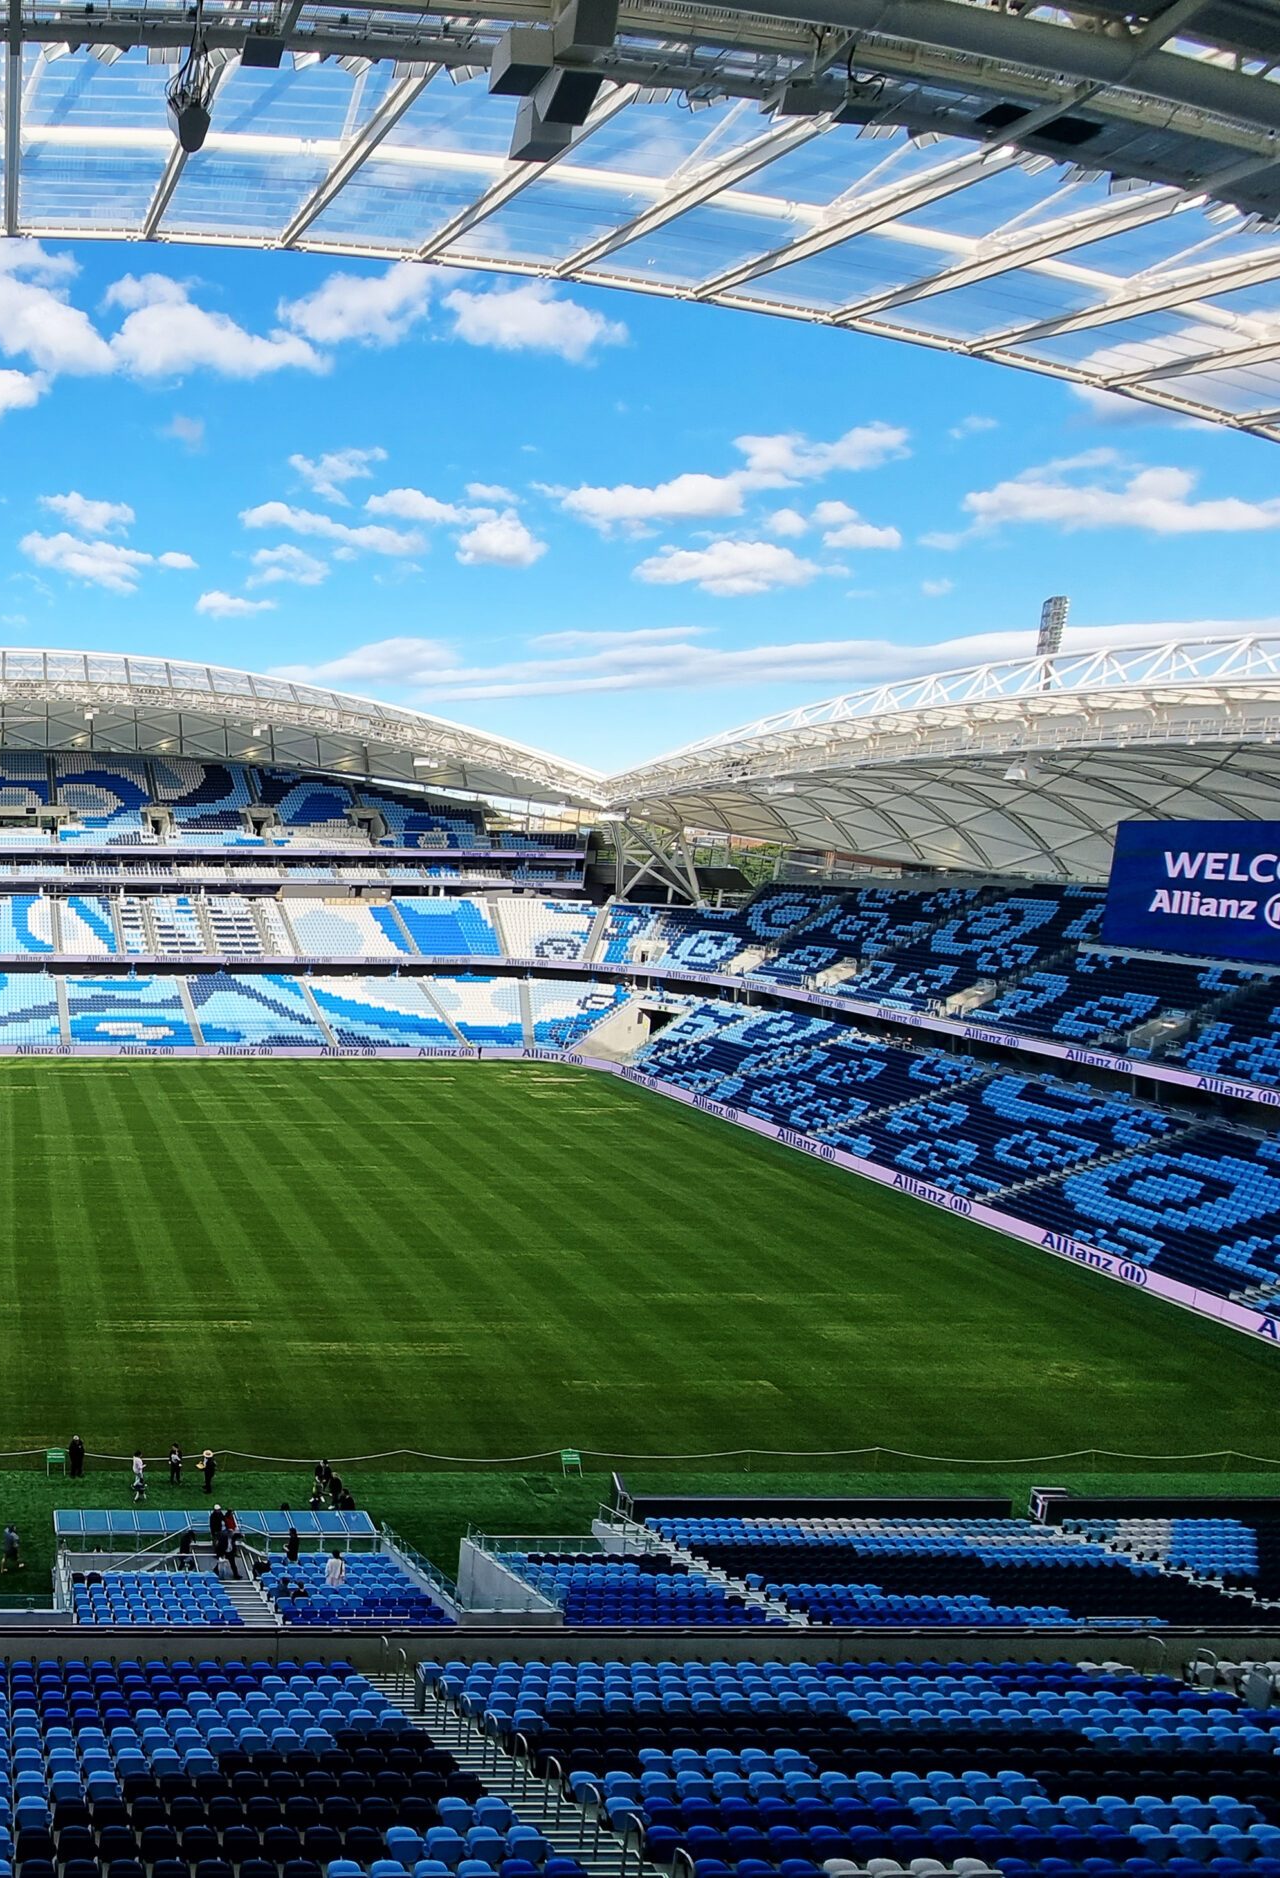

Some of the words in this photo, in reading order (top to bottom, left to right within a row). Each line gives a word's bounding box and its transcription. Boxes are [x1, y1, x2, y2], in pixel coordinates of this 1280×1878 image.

[1164, 852, 1280, 883] WELC
[1148, 889, 1258, 920] Allianz
[15, 954, 42, 962] Allianz
[293, 956, 320, 964] Allianz
[432, 957, 458, 965] Allianz
[505, 958, 535, 966] Allianz
[582, 962, 615, 972] Allianz
[665, 971, 697, 980] Allianz
[740, 981, 769, 992] Allianz
[807, 994, 833, 1007] Allianz
[877, 1009, 907, 1023] Allianz
[963, 1027, 1002, 1045] Allianz
[15, 1045, 54, 1055] Allianz
[119, 1045, 157, 1055] Allianz
[217, 1046, 256, 1055] Allianz
[320, 1047, 359, 1056] Allianz
[418, 1047, 457, 1057] Allianz
[521, 1048, 567, 1063] Allianz
[1065, 1049, 1111, 1069] Allianz
[620, 1066, 647, 1085] Allianz
[1197, 1077, 1255, 1100] Allianz
[693, 1095, 723, 1116] Allianz
[777, 1128, 817, 1152] Allianz
[892, 1173, 946, 1204] Allianz
[1041, 1231, 1113, 1272] Allianz
